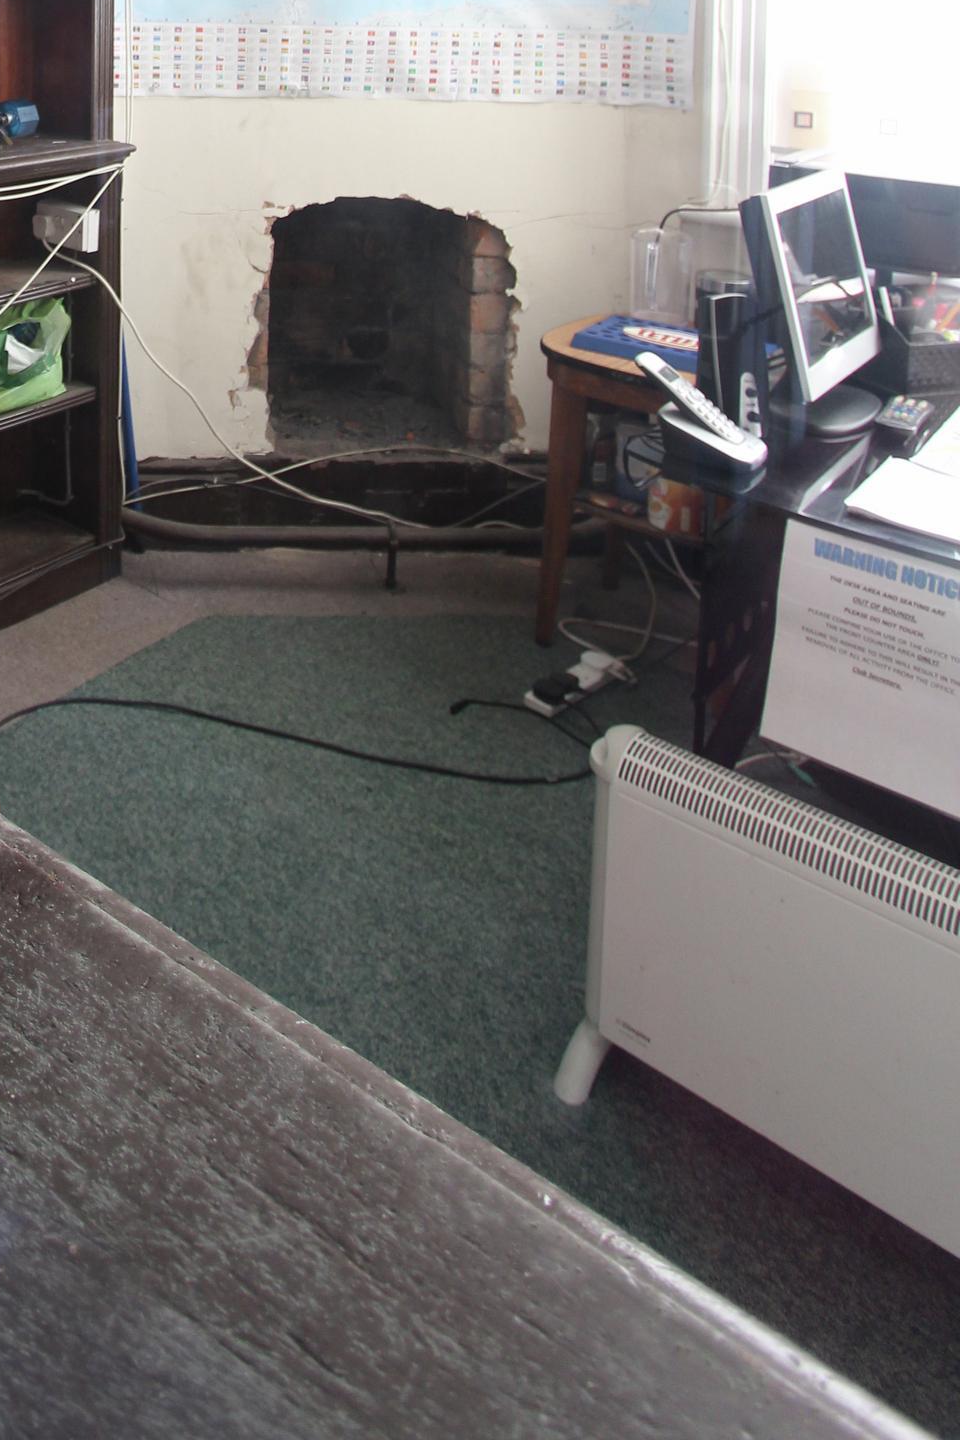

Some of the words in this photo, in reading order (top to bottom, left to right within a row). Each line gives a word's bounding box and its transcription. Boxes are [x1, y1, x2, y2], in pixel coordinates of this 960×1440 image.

[814, 538, 897, 581] WARNING
[901, 564, 960, 601] NOTIC
[852, 596, 869, 608] OUT
[870, 602, 881, 611] OF
[862, 586, 881, 597] AREA
[882, 592, 898, 602] AND
[900, 597, 930, 612] SEATING
[931, 607, 946, 617] ARE
[844, 607, 868, 620] PLEASE
[869, 615, 881, 624] DO
[882, 619, 897, 629] NOT
[807, 607, 830, 620] PLEASE
[923, 647, 948, 661] OFFICE
[897, 646, 916, 659] AREA
